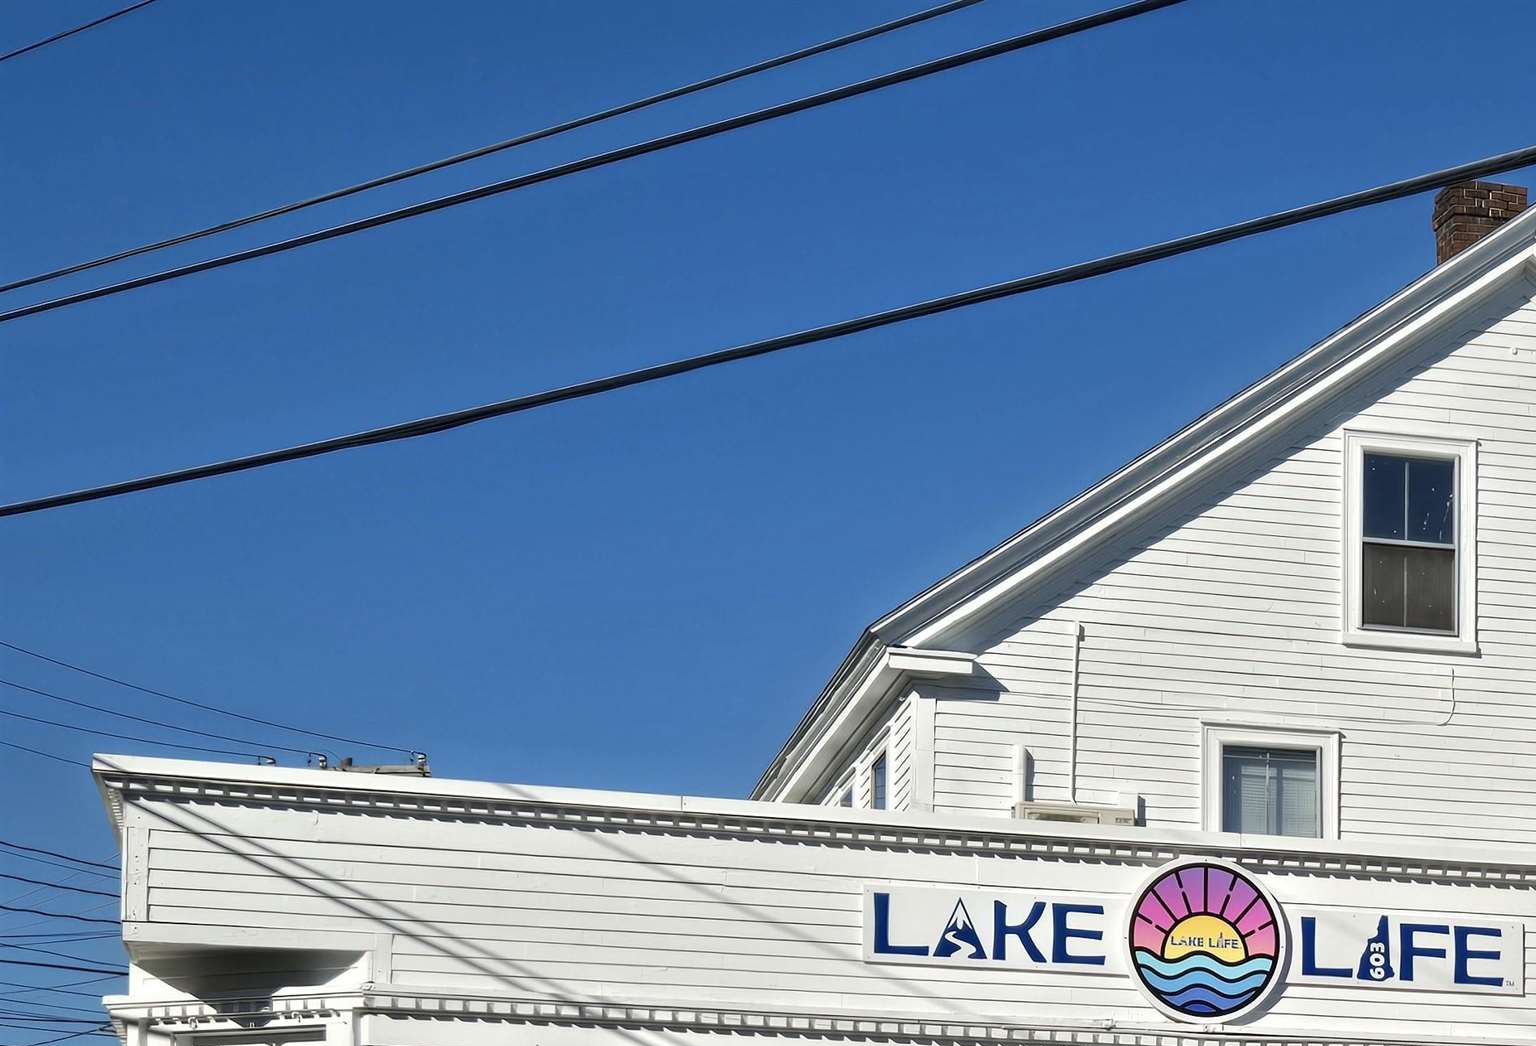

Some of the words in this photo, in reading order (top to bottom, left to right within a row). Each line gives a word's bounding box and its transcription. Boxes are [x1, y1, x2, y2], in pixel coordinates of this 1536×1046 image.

[873, 892, 1106, 966] LAKE
[1300, 914, 1504, 987] LIFE
[1171, 935, 1204, 947] LAKE
[1369, 942, 1385, 979] 603
